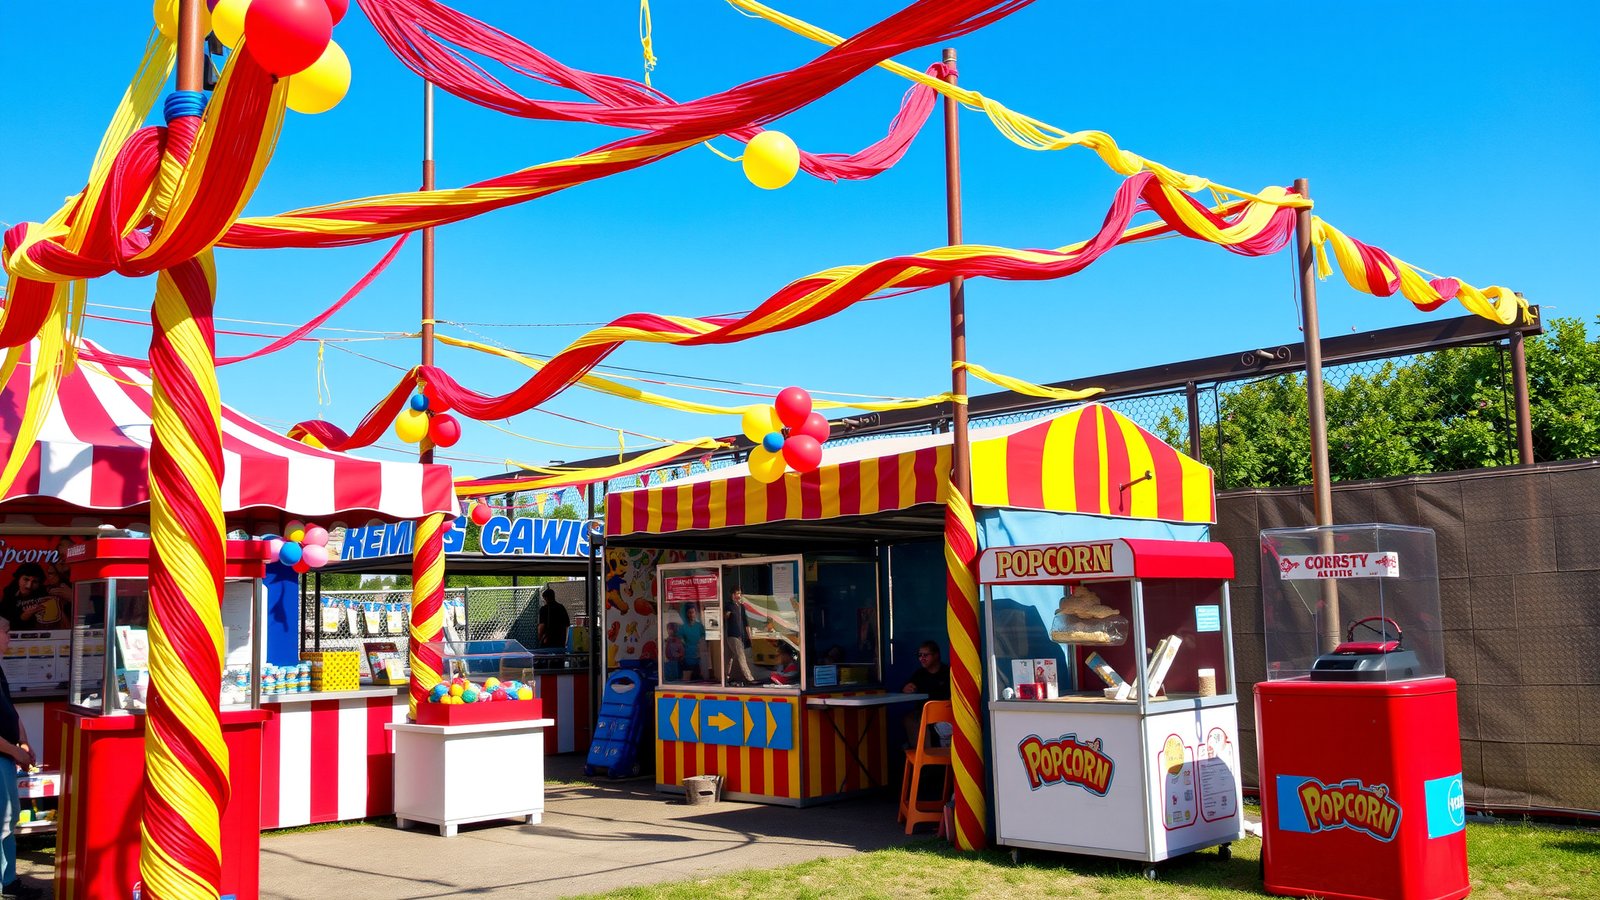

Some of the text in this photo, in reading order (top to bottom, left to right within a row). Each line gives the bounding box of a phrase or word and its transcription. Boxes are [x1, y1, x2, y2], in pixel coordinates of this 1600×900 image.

[0, 540, 59, 569] pcorn
[996, 544, 1113, 579] POPCORN
[1024, 741, 1111, 789] POPCORN
[1302, 786, 1397, 834] POPCORN
